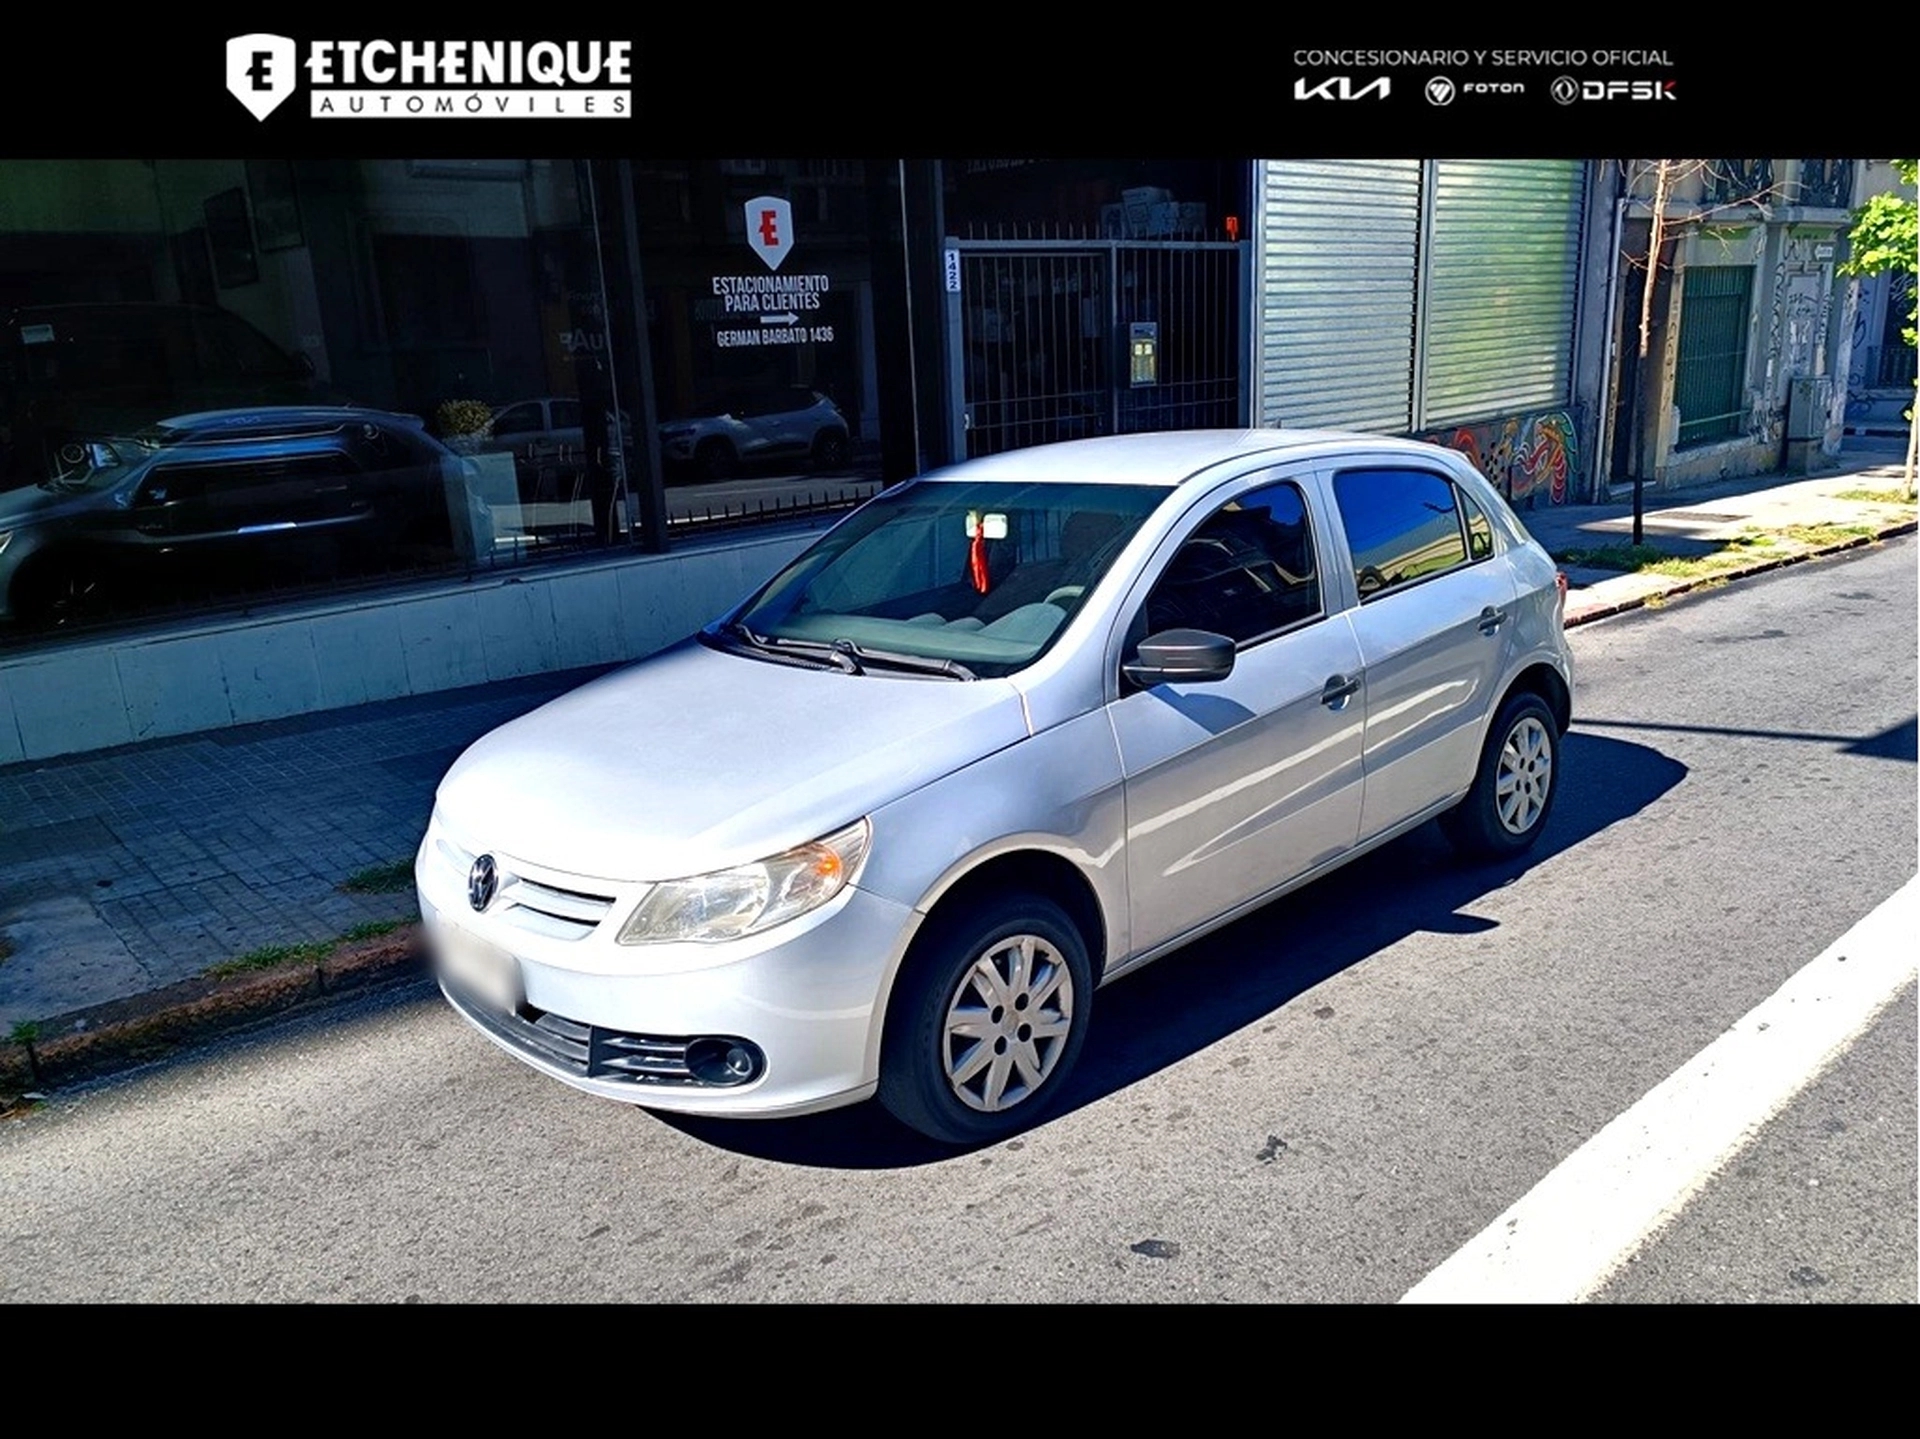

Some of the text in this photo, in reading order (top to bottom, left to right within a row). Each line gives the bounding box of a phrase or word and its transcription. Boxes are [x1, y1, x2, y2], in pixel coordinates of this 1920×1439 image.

[948, 253, 958, 289] 1422
[712, 275, 829, 295] ESTACIONAMIENTO
[725, 294, 759, 312] PARA
[762, 292, 820, 310] CLIENTES
[717, 326, 834, 347] GERMAN BARBATO 1436
